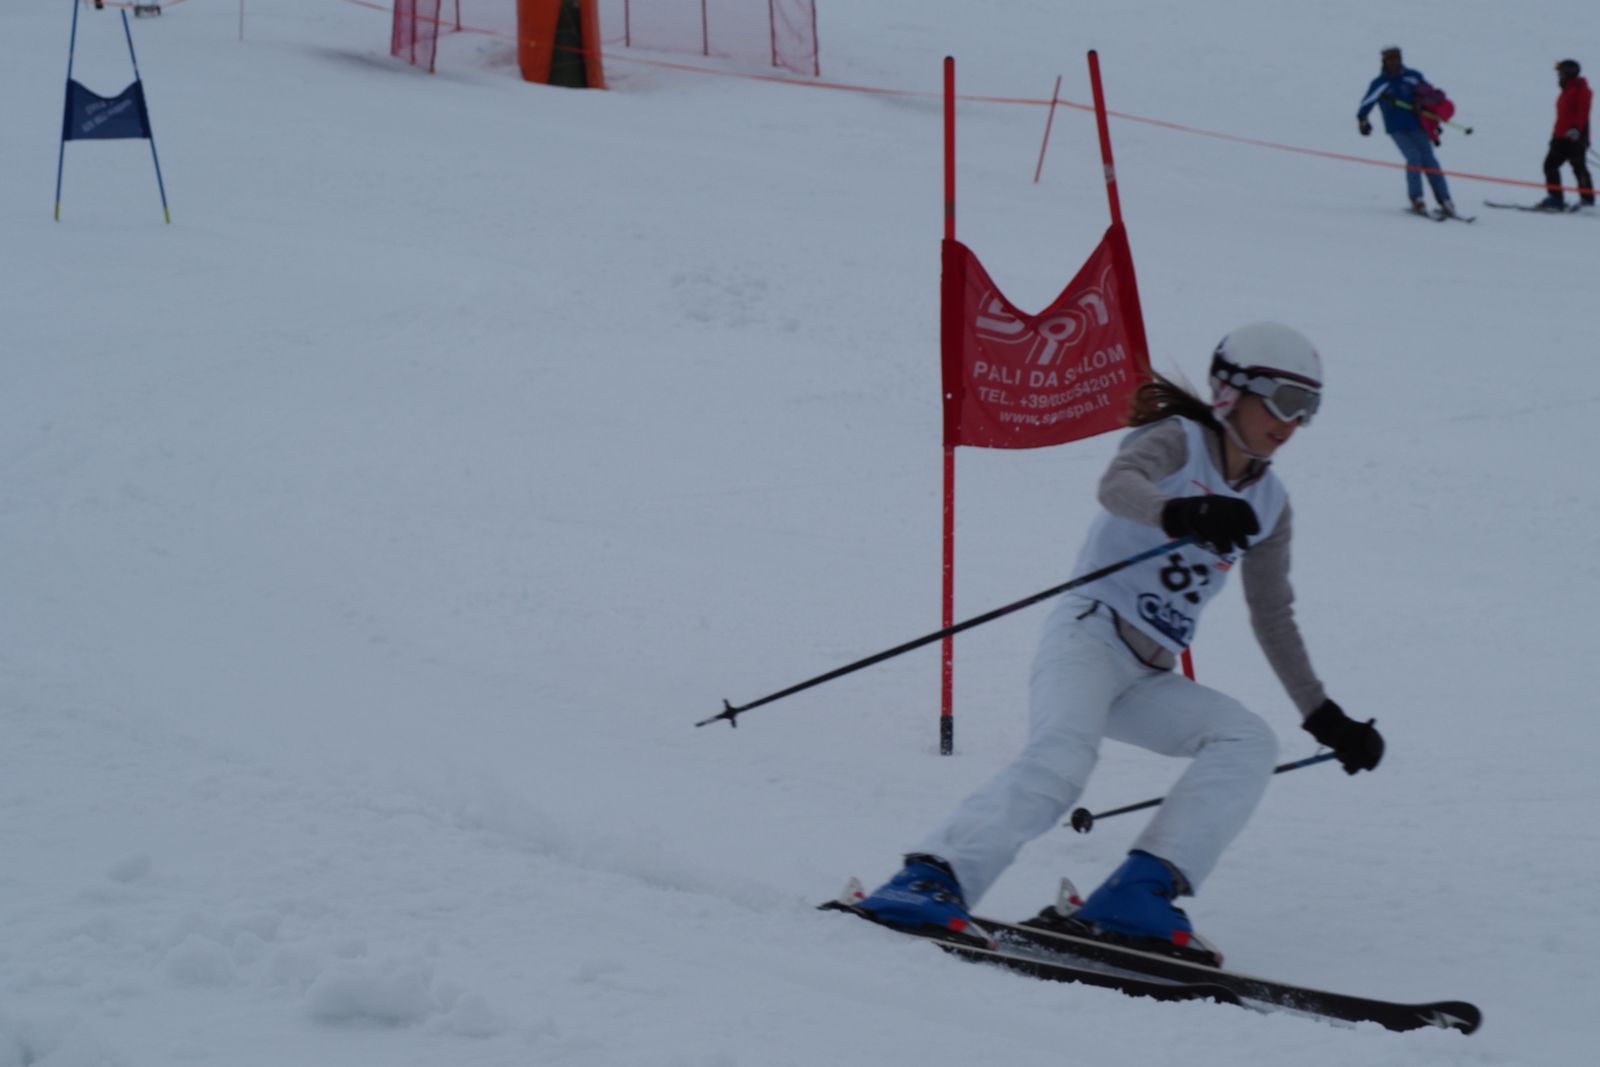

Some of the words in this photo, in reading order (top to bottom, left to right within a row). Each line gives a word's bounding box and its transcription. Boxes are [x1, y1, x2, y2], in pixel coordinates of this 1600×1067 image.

[972, 360, 1021, 385] PALI
[1029, 370, 1059, 388] DA
[1064, 344, 1127, 385] SLOM
[978, 386, 1014, 406] TEL.
